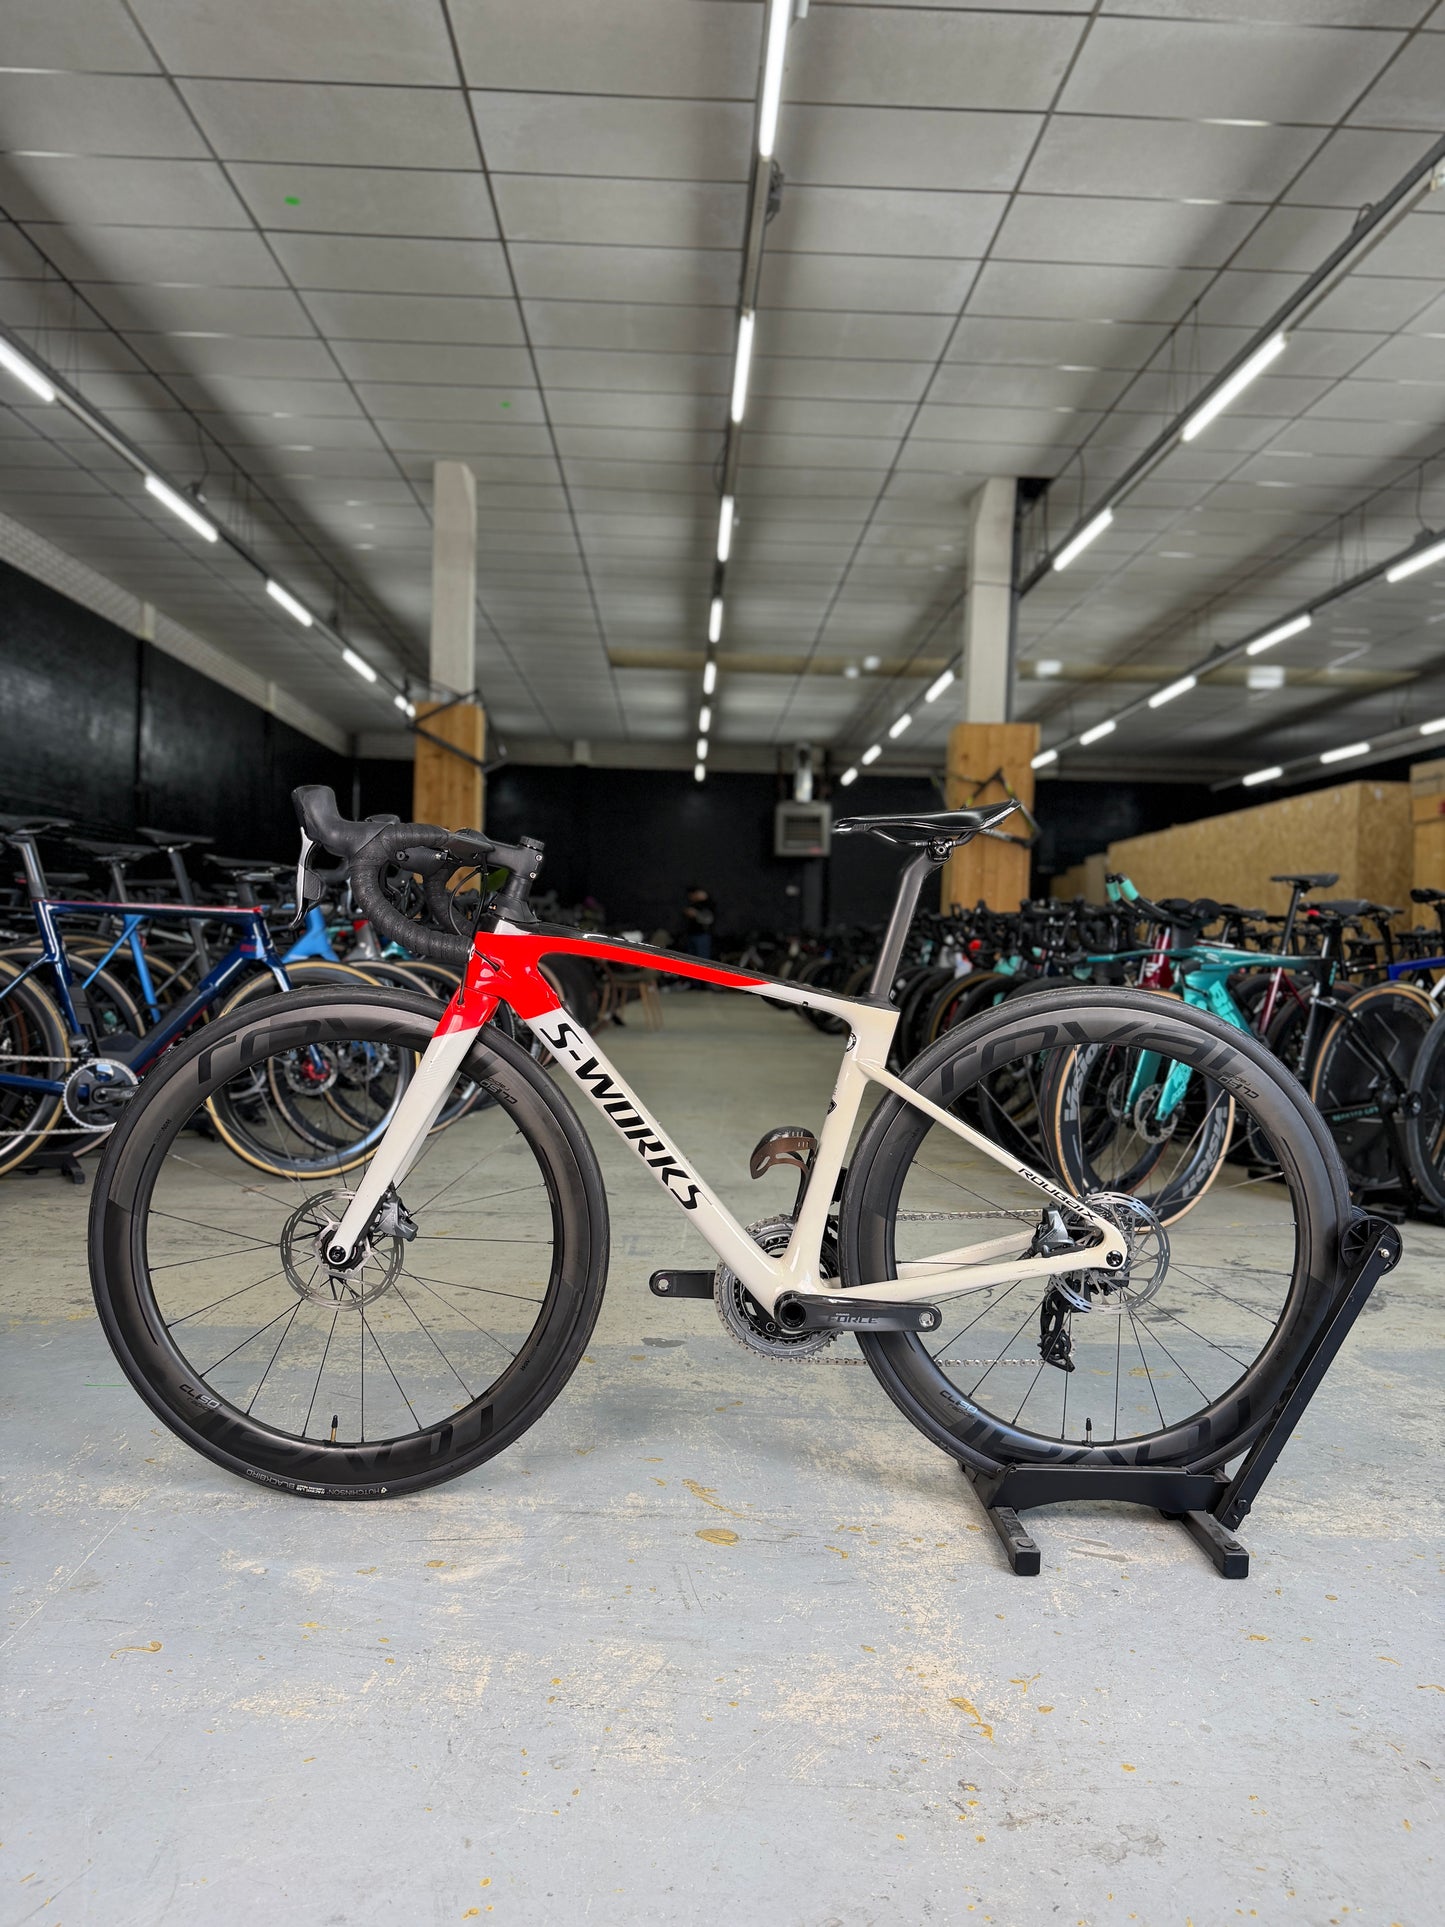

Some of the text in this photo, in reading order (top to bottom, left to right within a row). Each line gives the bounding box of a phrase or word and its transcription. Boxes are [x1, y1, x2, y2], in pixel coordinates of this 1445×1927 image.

[540, 1023, 713, 1210] S-WORKS
[827, 1315, 879, 1324] FORCE
[246, 1468, 295, 1490] BLACKBIRD
[329, 1487, 380, 1496] HUTCHINSON
